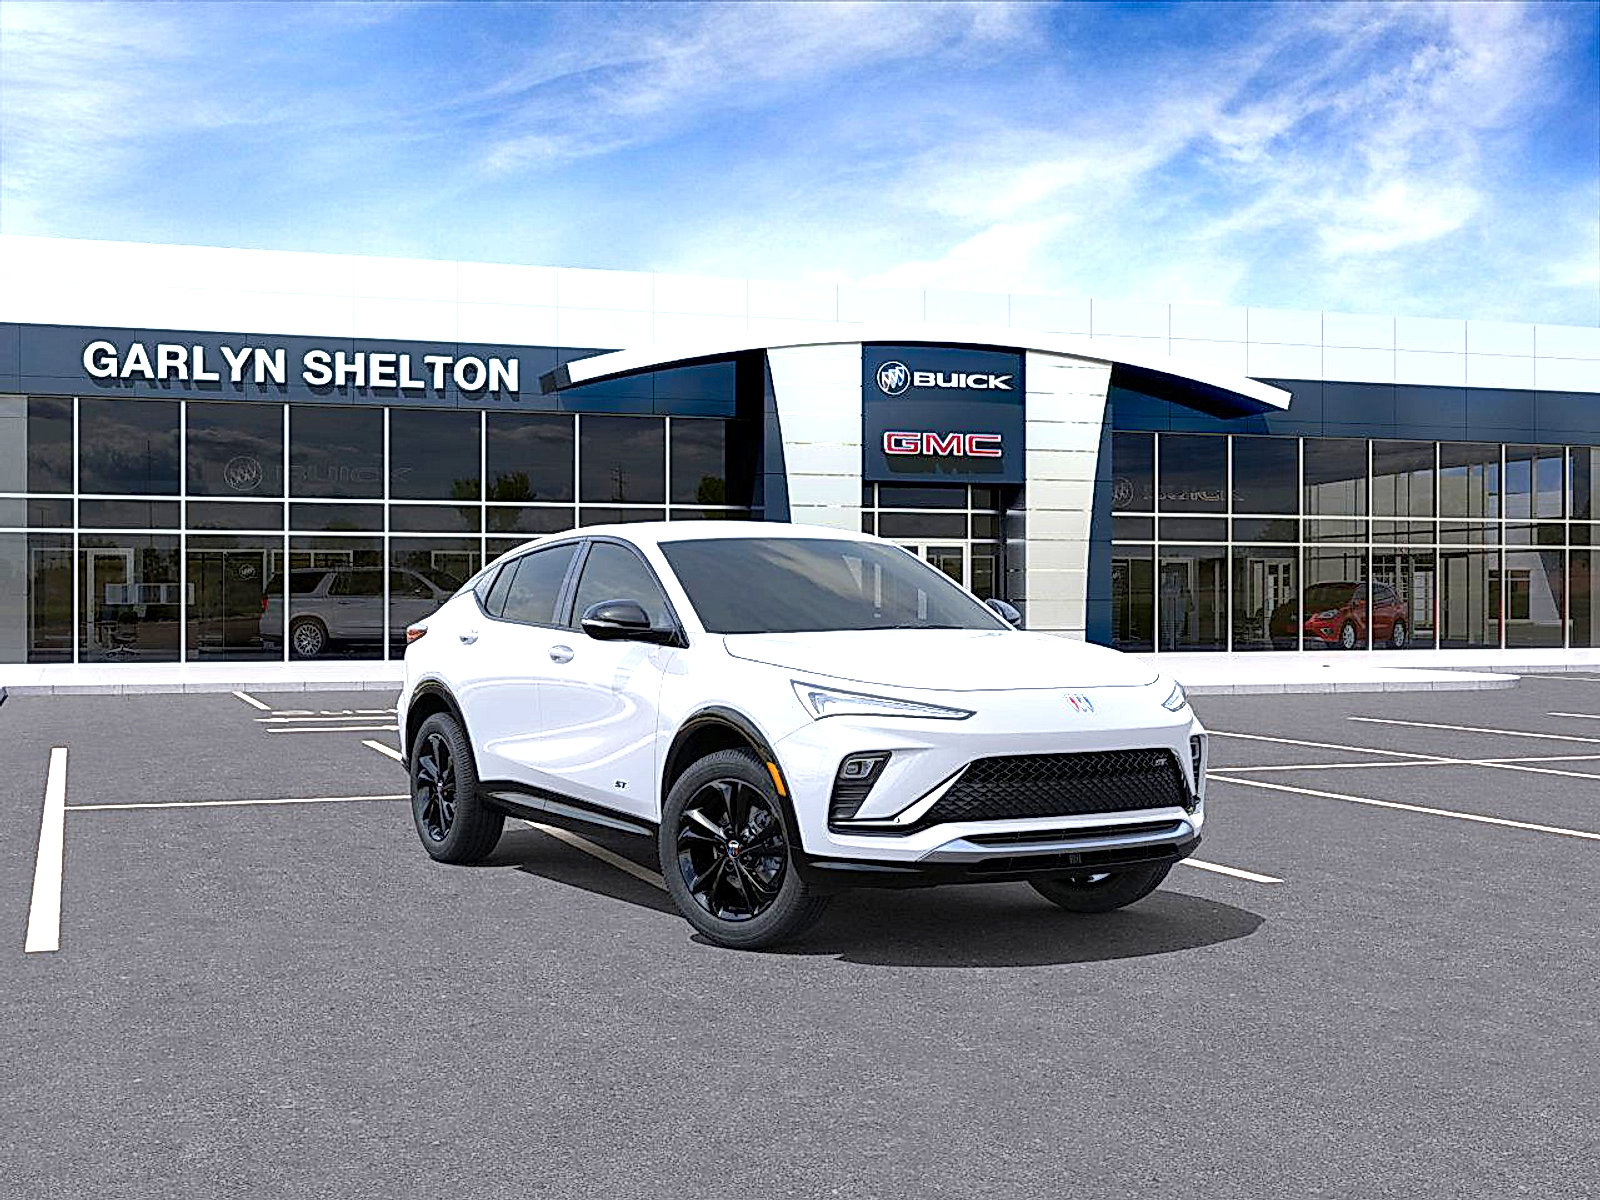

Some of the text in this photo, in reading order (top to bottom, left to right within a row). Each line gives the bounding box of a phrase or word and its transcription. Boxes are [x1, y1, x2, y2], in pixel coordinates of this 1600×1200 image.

[83, 341, 519, 391] GARLYN SHELTON
[913, 371, 1013, 390] BUICK
[884, 431, 1002, 457] GMC
[614, 780, 627, 789] ST
